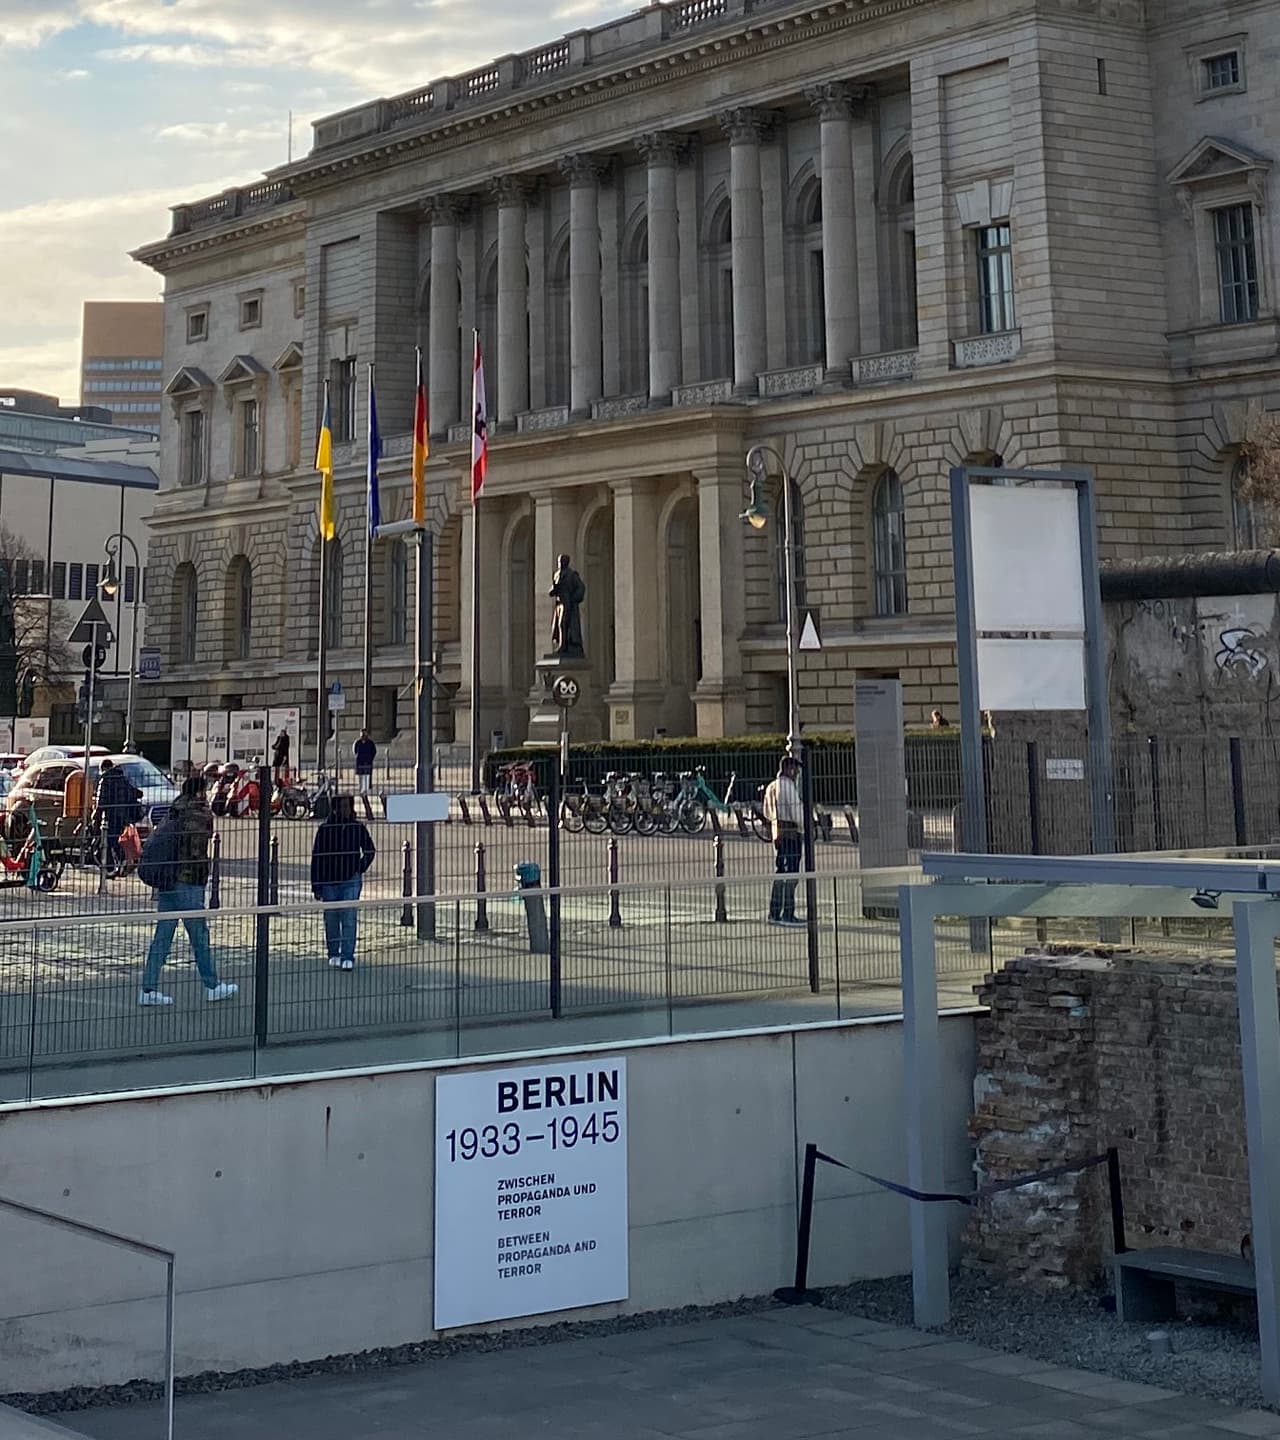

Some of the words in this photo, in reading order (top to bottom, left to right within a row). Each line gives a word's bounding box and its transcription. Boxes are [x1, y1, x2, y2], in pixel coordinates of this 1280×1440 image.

[497, 1070, 619, 1113] BERLIN
[497, 1173, 556, 1191] ZWISCHEN
[497, 1186, 571, 1206] PROPAGANDA
[573, 1183, 597, 1197] UND
[497, 1205, 542, 1221] TERROR
[497, 1231, 551, 1249] BETWEEN
[497, 1243, 571, 1264] PROPAGANDA
[574, 1239, 597, 1253] AND
[497, 1263, 542, 1280] TERROR
